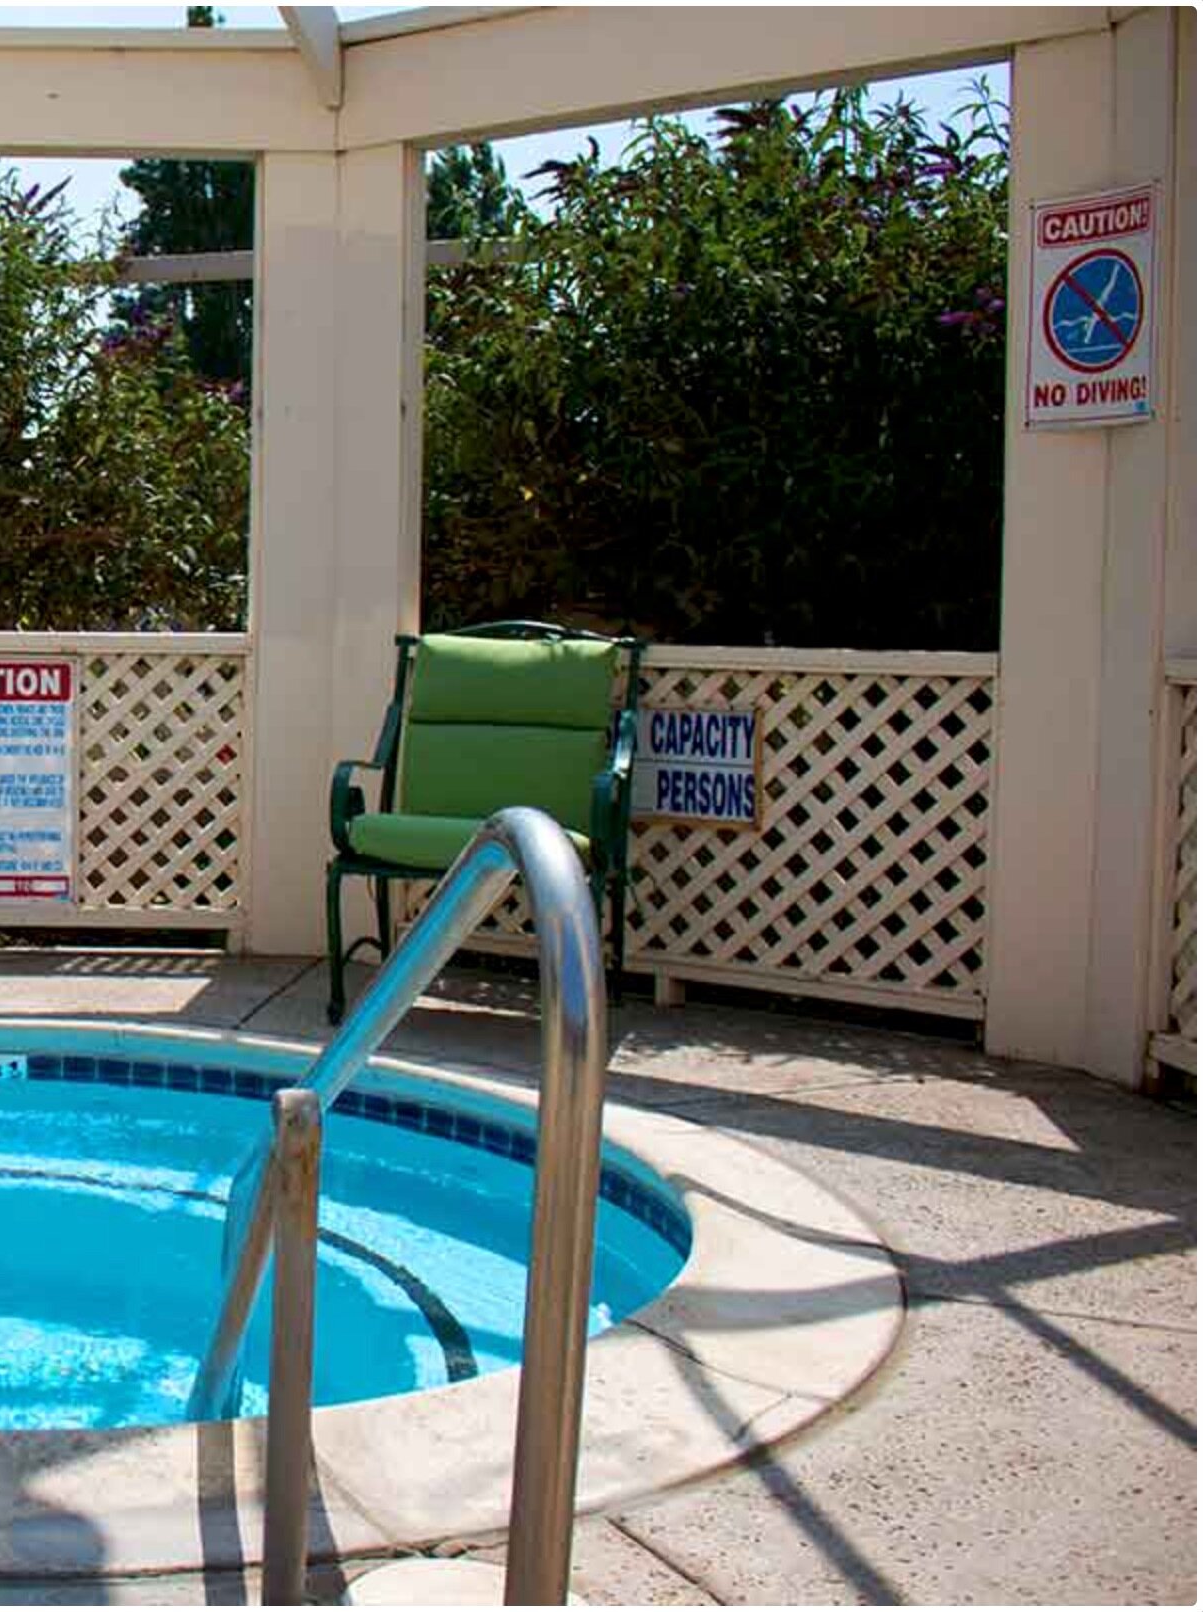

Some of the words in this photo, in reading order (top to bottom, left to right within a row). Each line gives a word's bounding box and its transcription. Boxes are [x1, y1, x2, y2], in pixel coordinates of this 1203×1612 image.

[1045, 203, 1147, 241] CAUTION!
[1034, 385, 1066, 407] NO
[1077, 376, 1147, 405] DIVING!
[651, 713, 755, 759] CAPACITY
[657, 769, 755, 817] PERSONS
